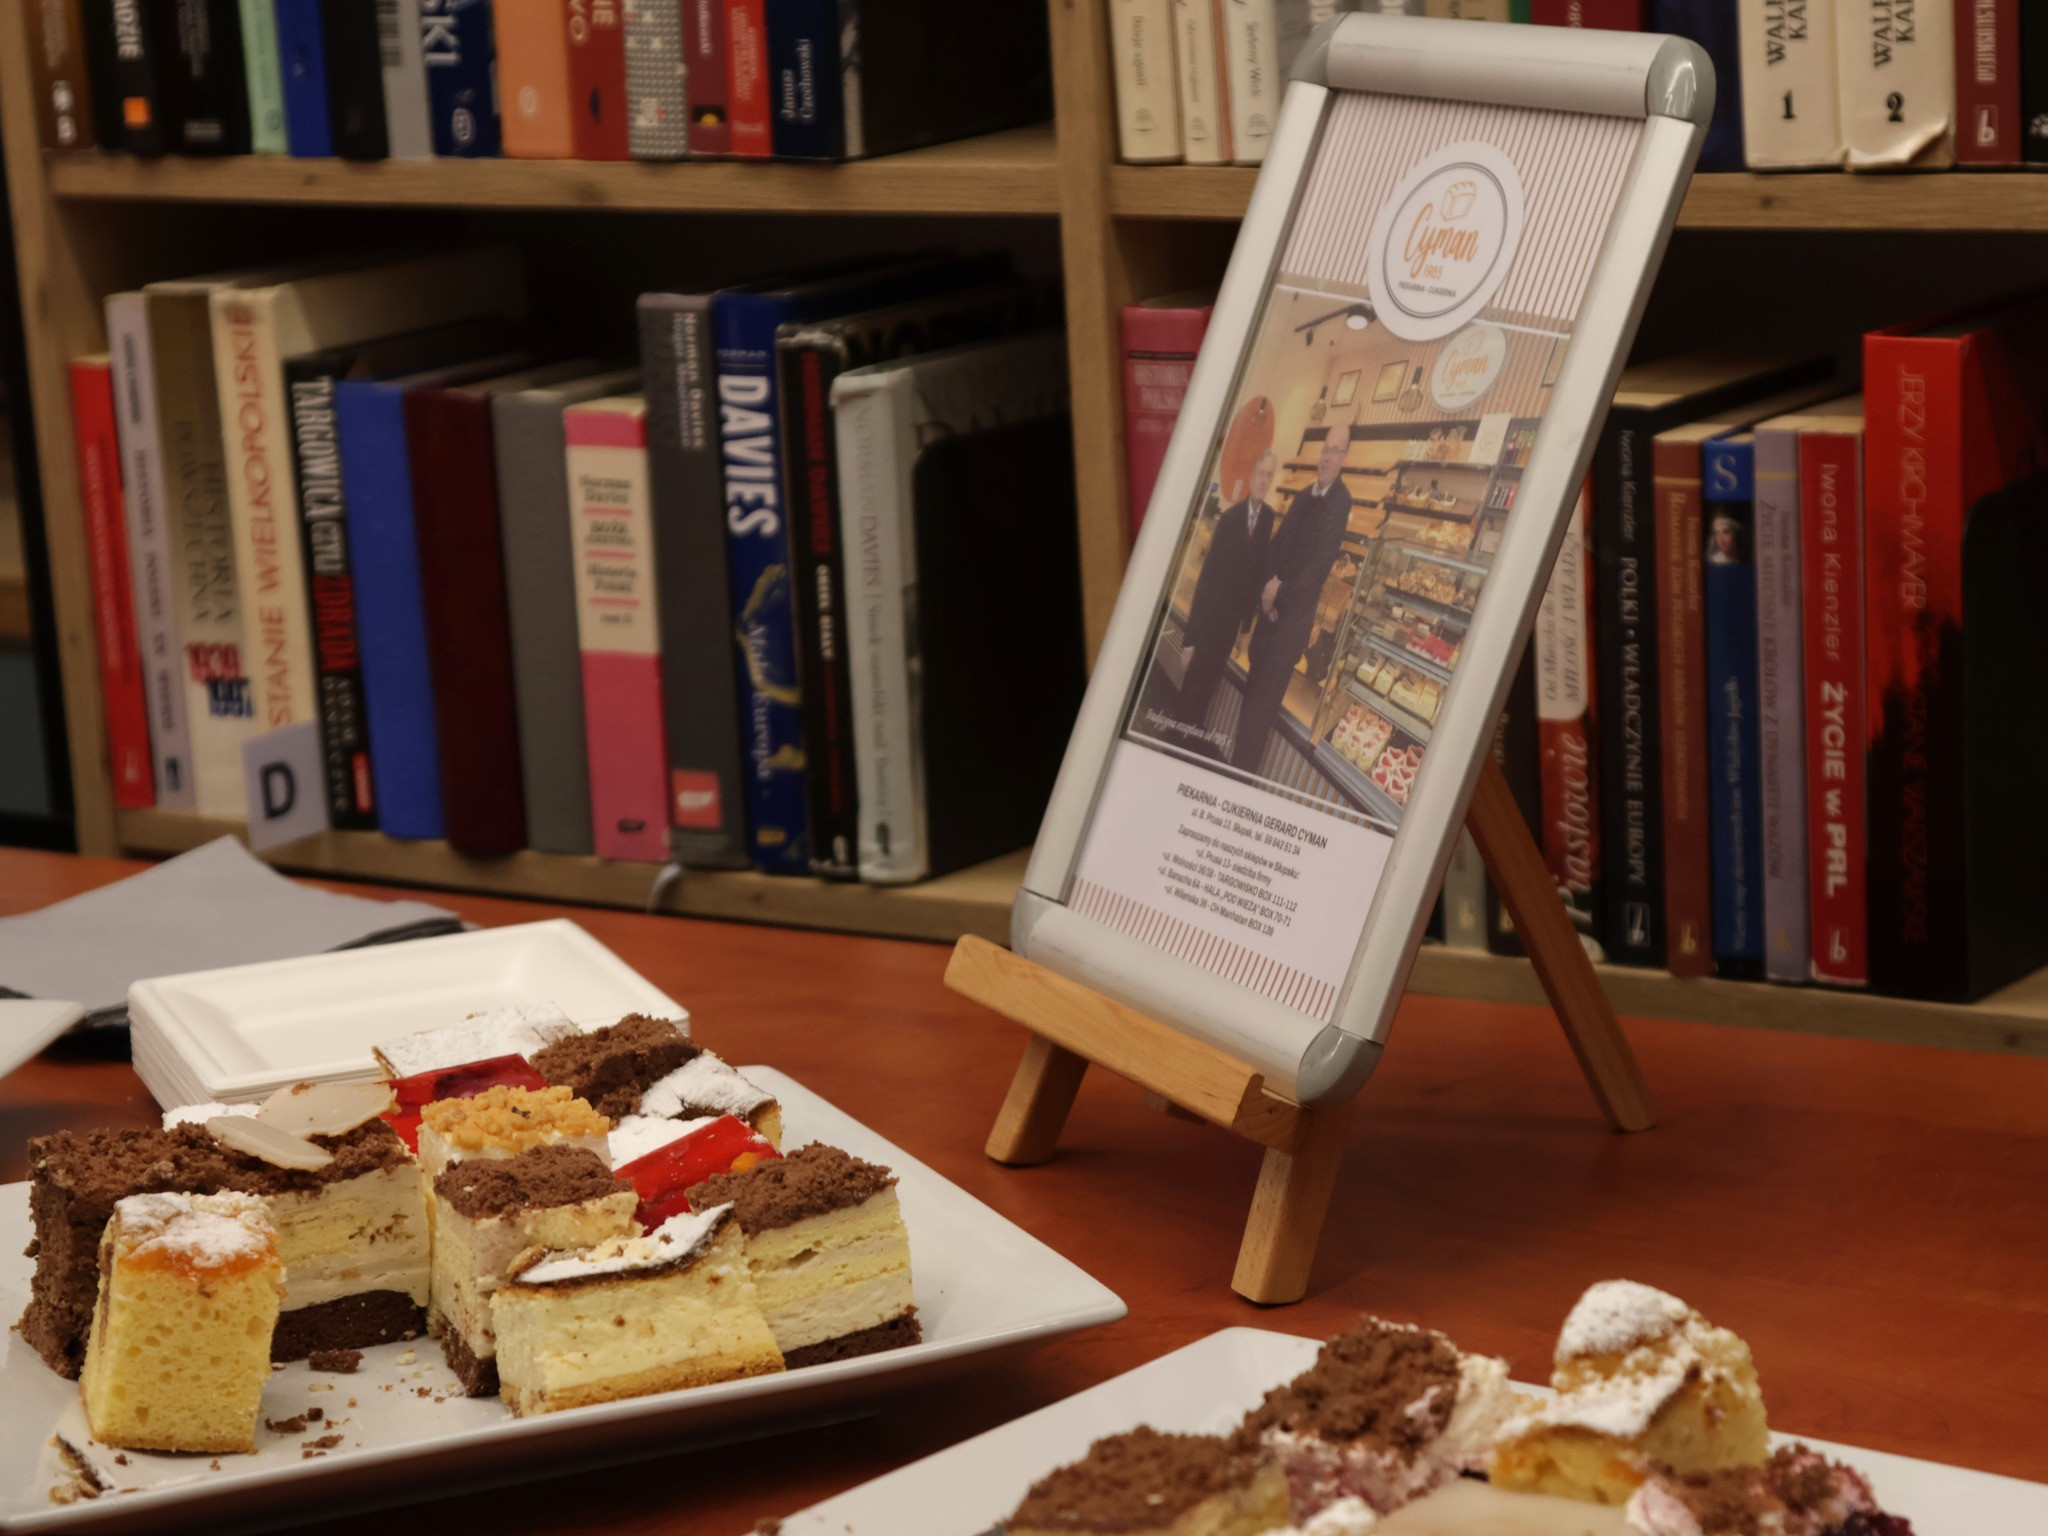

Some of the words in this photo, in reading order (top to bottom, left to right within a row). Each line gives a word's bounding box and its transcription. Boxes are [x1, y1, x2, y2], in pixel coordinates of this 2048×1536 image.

[1782, 89, 1796, 120] 1
[1886, 91, 1905, 122] 2
[1404, 202, 1479, 278] Cyman
[689, 387, 704, 448] Davies
[1901, 363, 1926, 440] JERZY
[292, 375, 344, 519] TARGOWICA
[718, 374, 780, 537] DAVIES
[1620, 429, 1635, 477] Iwona
[1713, 453, 1738, 493] S
[1620, 481, 1638, 542] Kienzler
[1820, 463, 1839, 544] Iwona
[1902, 447, 1927, 609] KIRCHMAYER
[310, 520, 345, 576] CZYLI
[859, 515, 882, 588] DAVIES
[1619, 557, 1639, 622] POLKI
[1824, 552, 1842, 662] Kienzler
[312, 575, 357, 675] ZDRADA
[260, 605, 293, 728] STANIE
[1620, 643, 1644, 791] WŁADCZYNIE
[1820, 680, 1846, 780] ŻYCIE
[260, 761, 295, 821] D
[1176, 782, 1218, 807] PIEKARNIA
[1220, 799, 1264, 824] CUKIERNIA
[1263, 815, 1298, 837] GERARD
[1297, 828, 1328, 848] CYMAN
[1823, 788, 1841, 818] w
[1176, 823, 1212, 846] Zapraszamy
[1211, 837, 1220, 847] do
[1218, 840, 1244, 858] naszych
[1205, 812, 1223, 826] Prusa
[1253, 830, 1264, 841] tel.
[1557, 731, 1592, 925] Piastowie
[1625, 801, 1646, 885] EUROPY
[1205, 850, 1223, 864] Prusa
[1255, 870, 1272, 886] firmy
[1216, 872, 1258, 895] TARGOWISKO
[1257, 888, 1272, 901] BOX
[1271, 894, 1298, 912] 111-112
[1825, 823, 1847, 898] PRL
[1202, 884, 1220, 898] HALA
[1259, 906, 1274, 919] BOX
[1273, 912, 1291, 926] 70-71
[1209, 903, 1220, 913] CH
[1247, 918, 1262, 931] BOX
